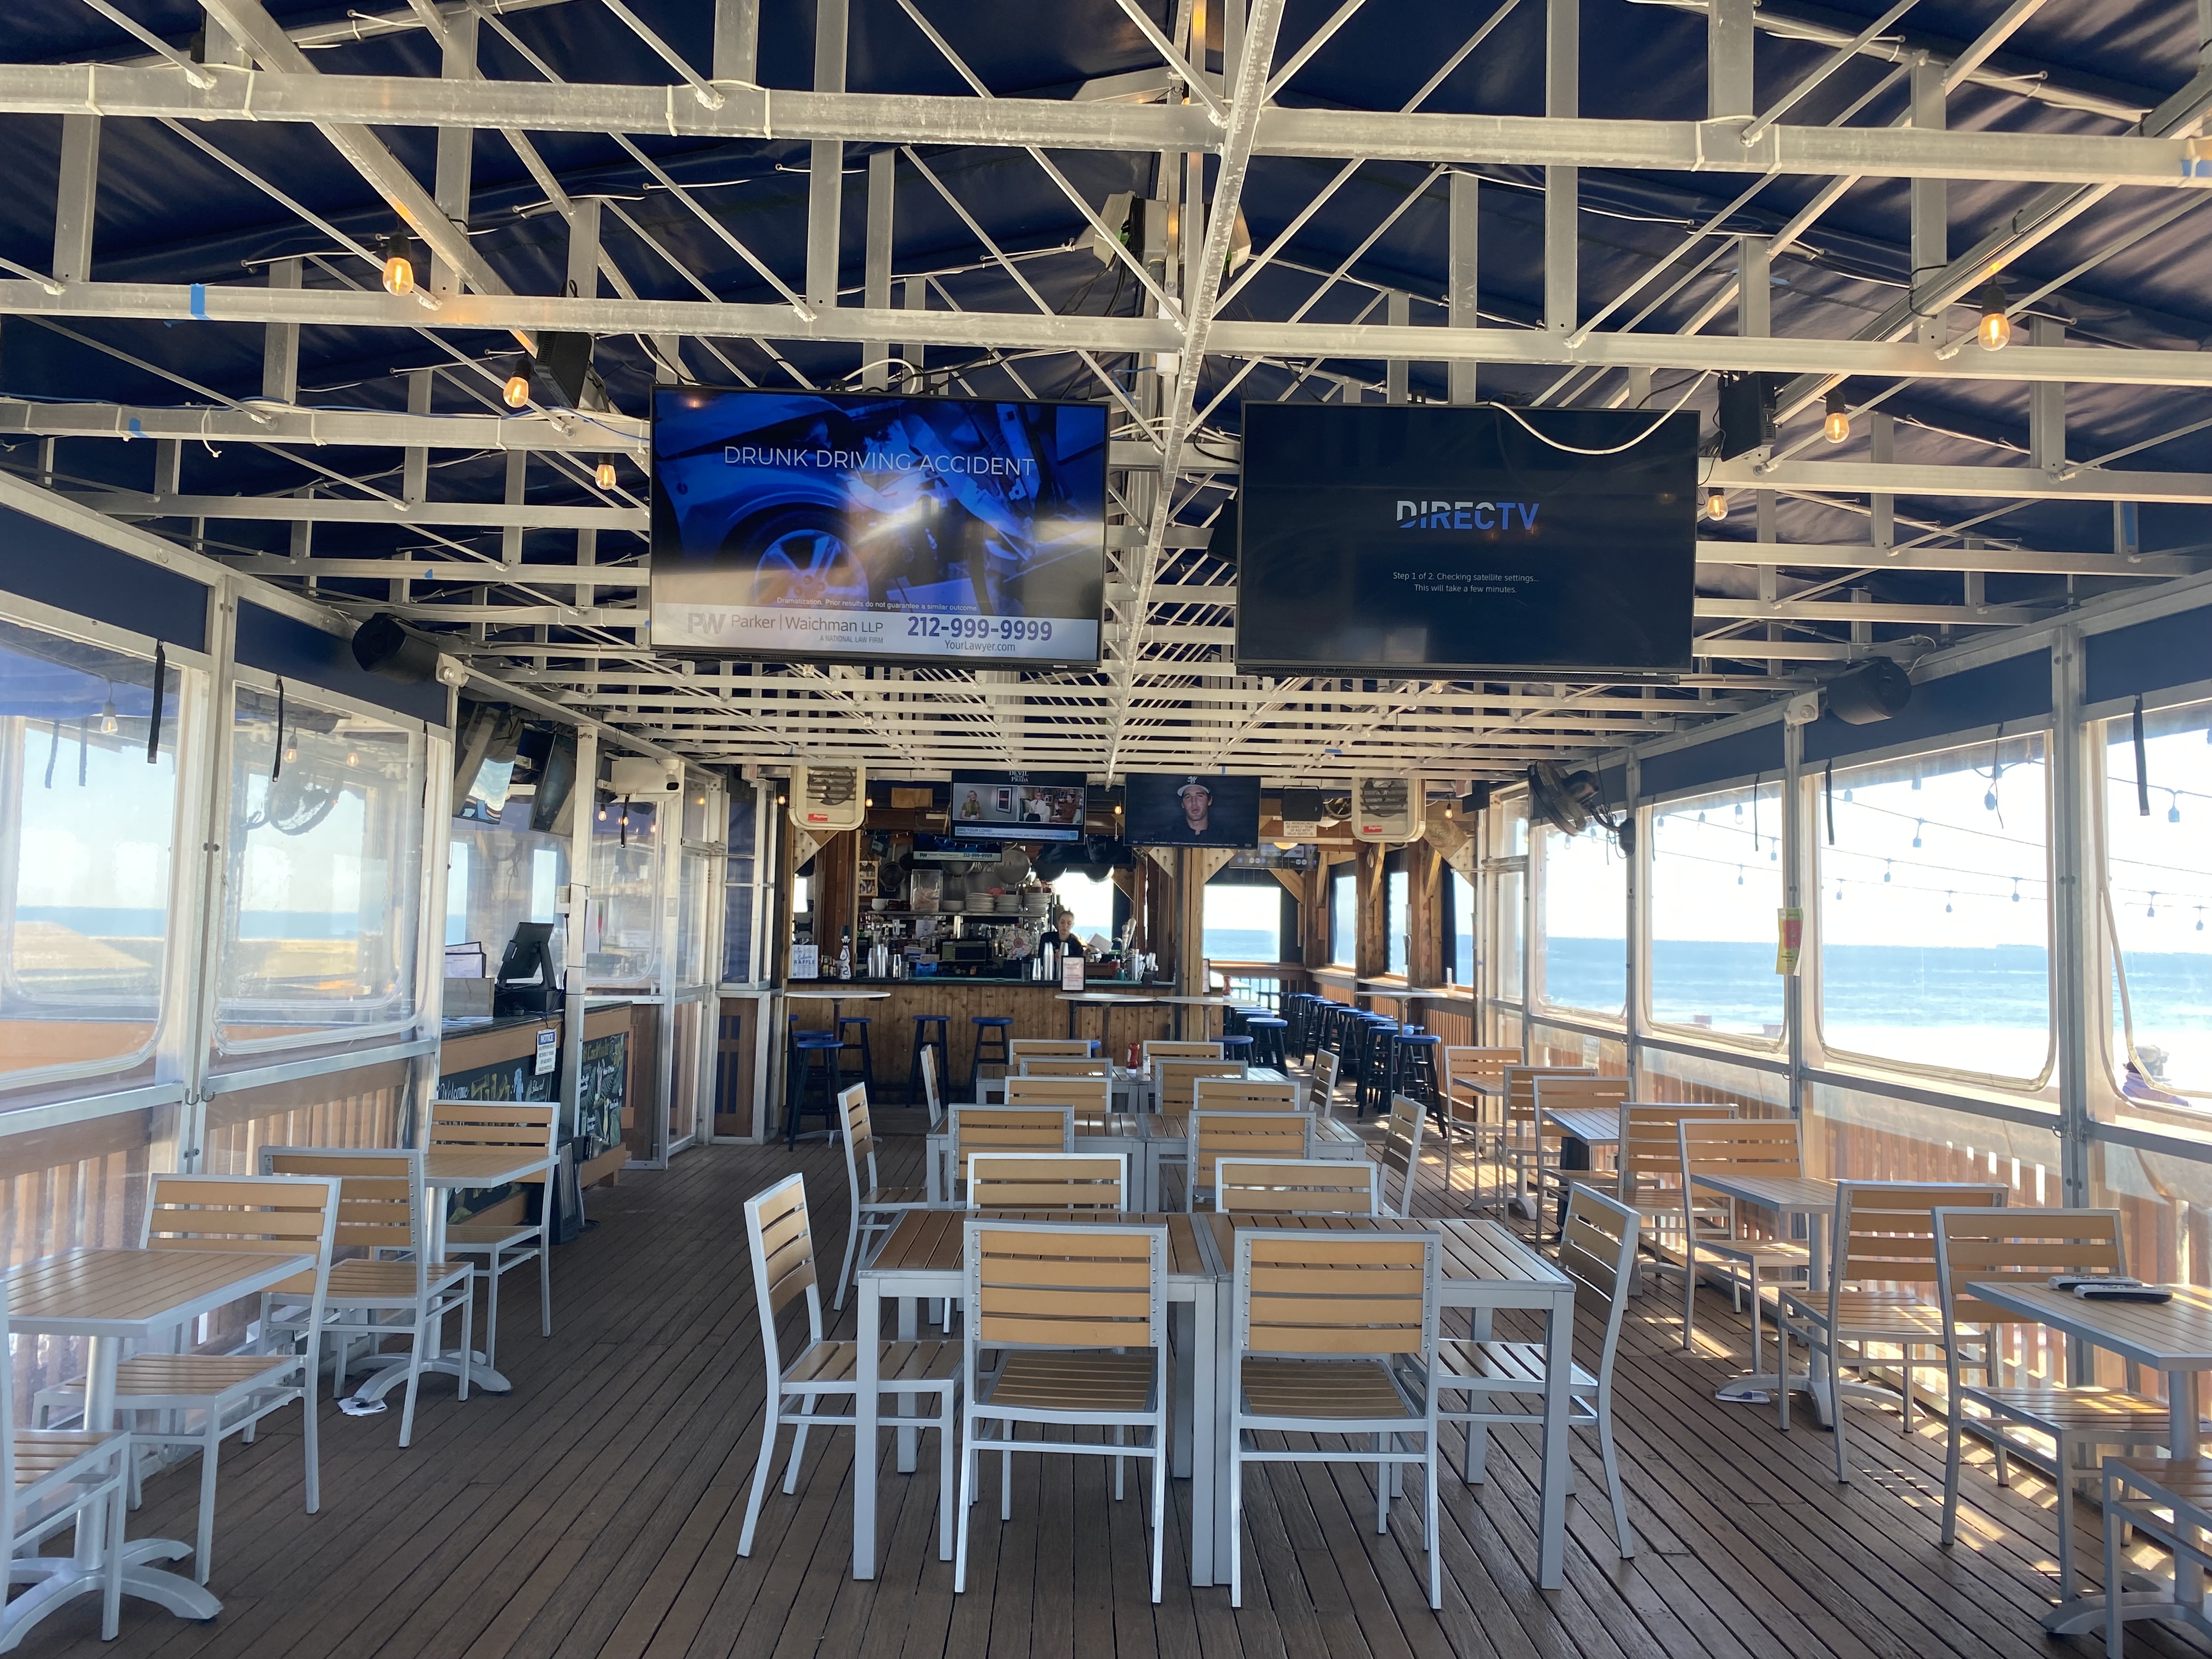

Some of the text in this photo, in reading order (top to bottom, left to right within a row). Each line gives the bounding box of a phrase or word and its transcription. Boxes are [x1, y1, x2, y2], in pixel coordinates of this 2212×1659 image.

[724, 446, 1035, 476] DRUNK DRIVING ACCIDENT
[1396, 500, 1539, 530] DIRECTV
[1393, 572, 1409, 581] Step
[1437, 573, 1471, 582] Checking
[777, 597, 823, 605] Dramatization.
[687, 613, 726, 634] PW
[731, 614, 883, 633] Parker Waichman LLP
[907, 616, 1052, 641] 212-999-9999
[945, 640, 1015, 652] YourLawyer.com
[540, 1033, 554, 1043] NOTICE
